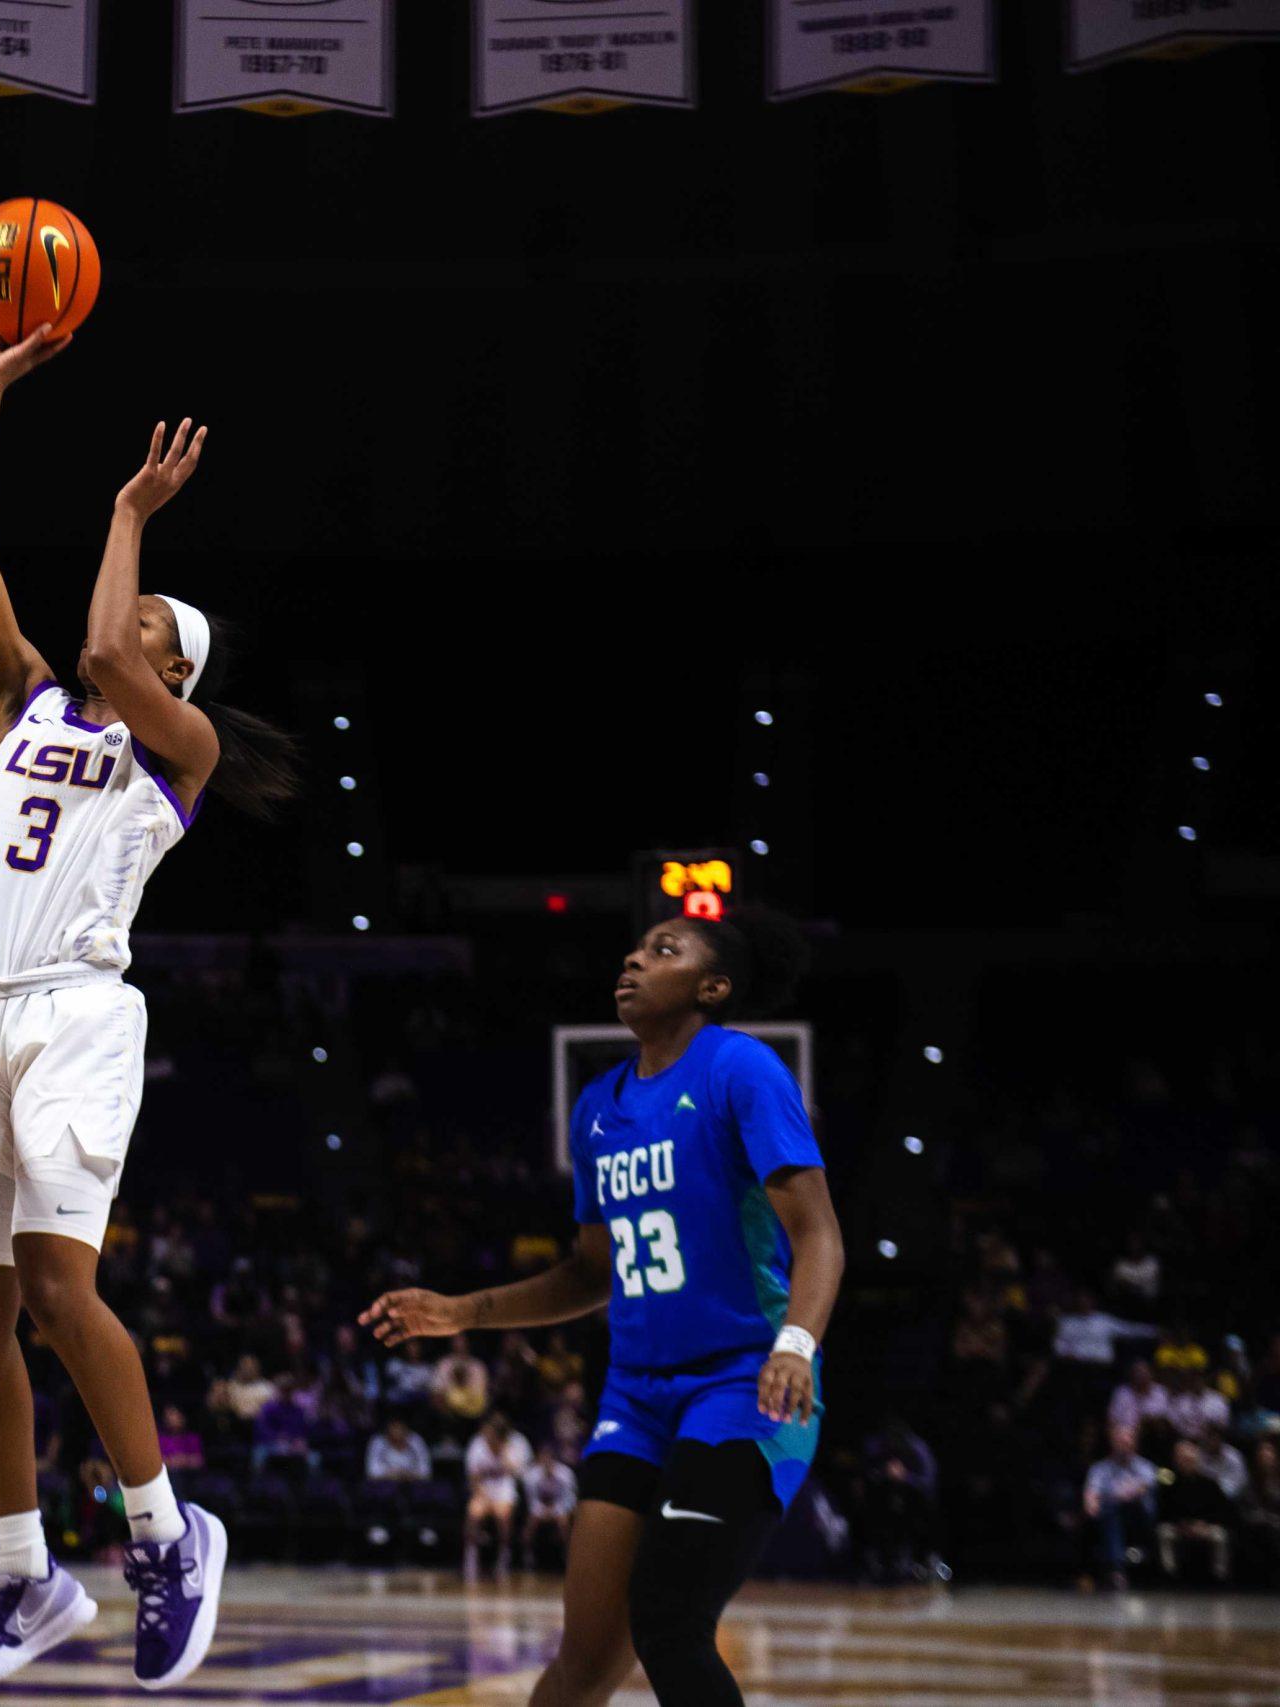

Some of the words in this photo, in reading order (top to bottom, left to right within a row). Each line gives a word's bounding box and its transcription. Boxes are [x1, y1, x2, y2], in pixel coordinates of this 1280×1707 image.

[4, 739, 117, 791] LSU
[5, 795, 63, 873] 3
[596, 1139, 675, 1206] FGCU
[610, 1209, 686, 1298] 23
